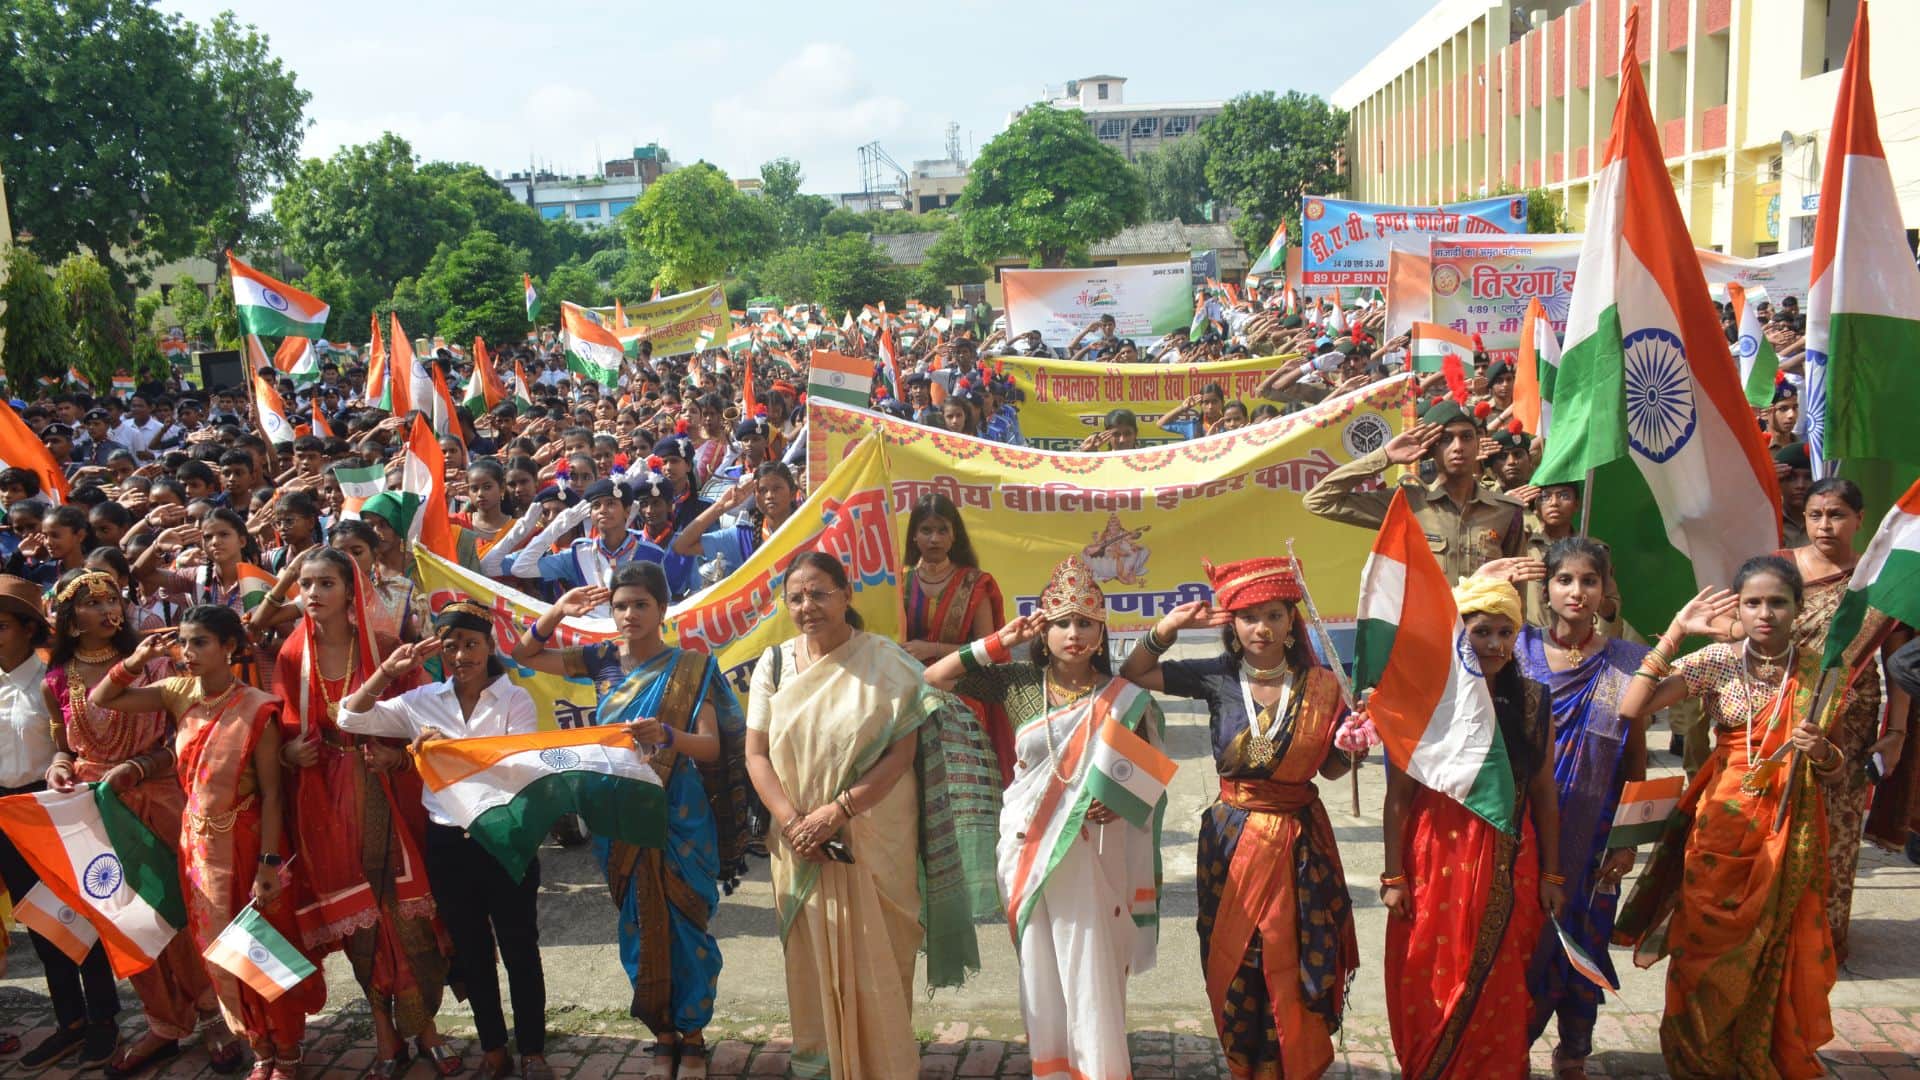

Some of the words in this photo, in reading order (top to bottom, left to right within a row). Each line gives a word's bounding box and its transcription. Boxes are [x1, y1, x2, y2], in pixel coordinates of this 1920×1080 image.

[1373, 212, 1408, 238] इण्टर
[1413, 207, 1459, 233] कालेज
[1465, 249, 1475, 257] का
[1313, 273, 1329, 283] 89
[1332, 273, 1350, 283] UP
[1354, 273, 1373, 283] BN
[1473, 264, 1556, 298] तिरंगा
[1035, 366, 1048, 402] श्री
[1052, 374, 1100, 401] कमलाकर
[1103, 369, 1124, 401] चौबे
[1128, 369, 1159, 401] आदर्श
[1164, 369, 1185, 401] सेवा
[891, 475, 994, 513] जकीय
[1001, 482, 1146, 512] बालिका
[1155, 471, 1249, 510] इण्टर
[1254, 449, 1388, 493] काले
